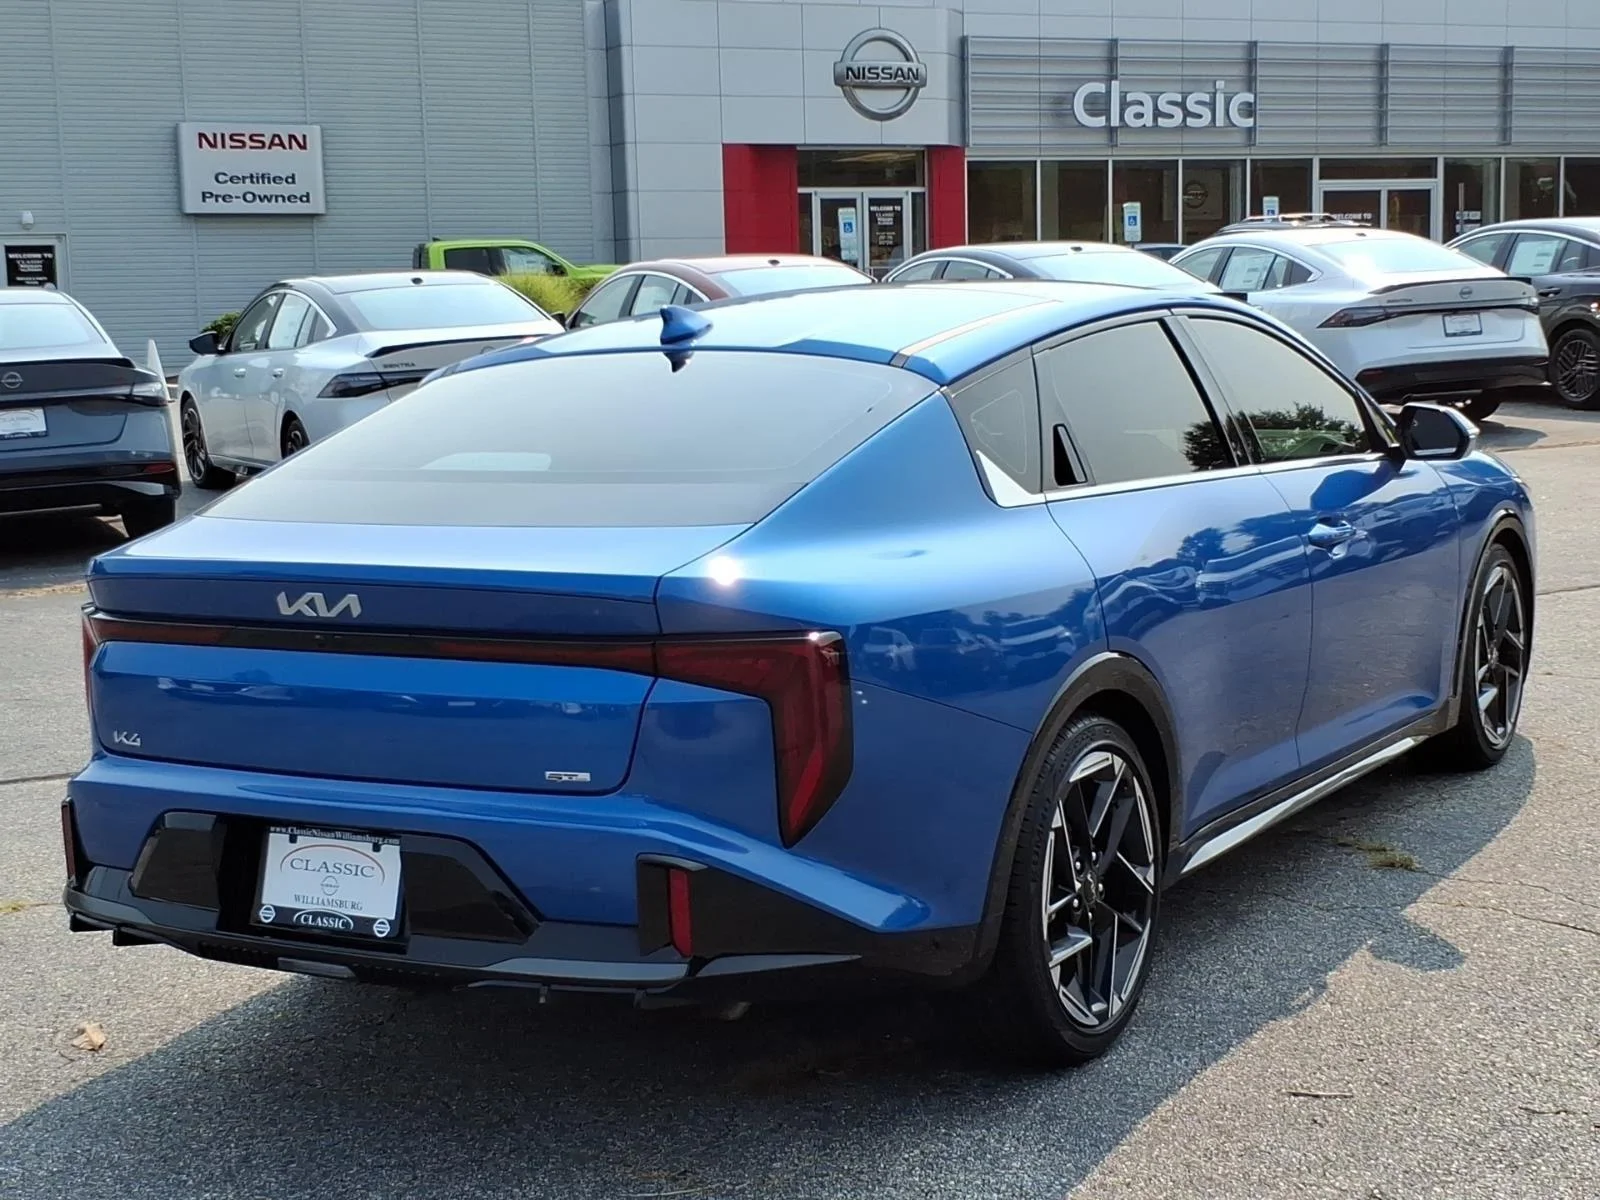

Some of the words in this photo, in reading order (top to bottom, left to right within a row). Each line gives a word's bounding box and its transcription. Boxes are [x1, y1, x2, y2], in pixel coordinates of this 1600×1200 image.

[845, 66, 919, 80] NISSAN
[1073, 80, 1255, 127] Classic
[198, 132, 308, 150] NISSAN
[214, 171, 297, 185] Certified
[201, 191, 311, 204] Pre-Owned
[276, 591, 362, 618] KIA
[113, 730, 141, 747] K4
[269, 826, 400, 844] www.ClassicNissanWilliamsburg.com
[290, 858, 375, 877] CLASSIC
[294, 894, 363, 910] WILLIAMSBURG
[301, 915, 346, 929] CLASSIC
